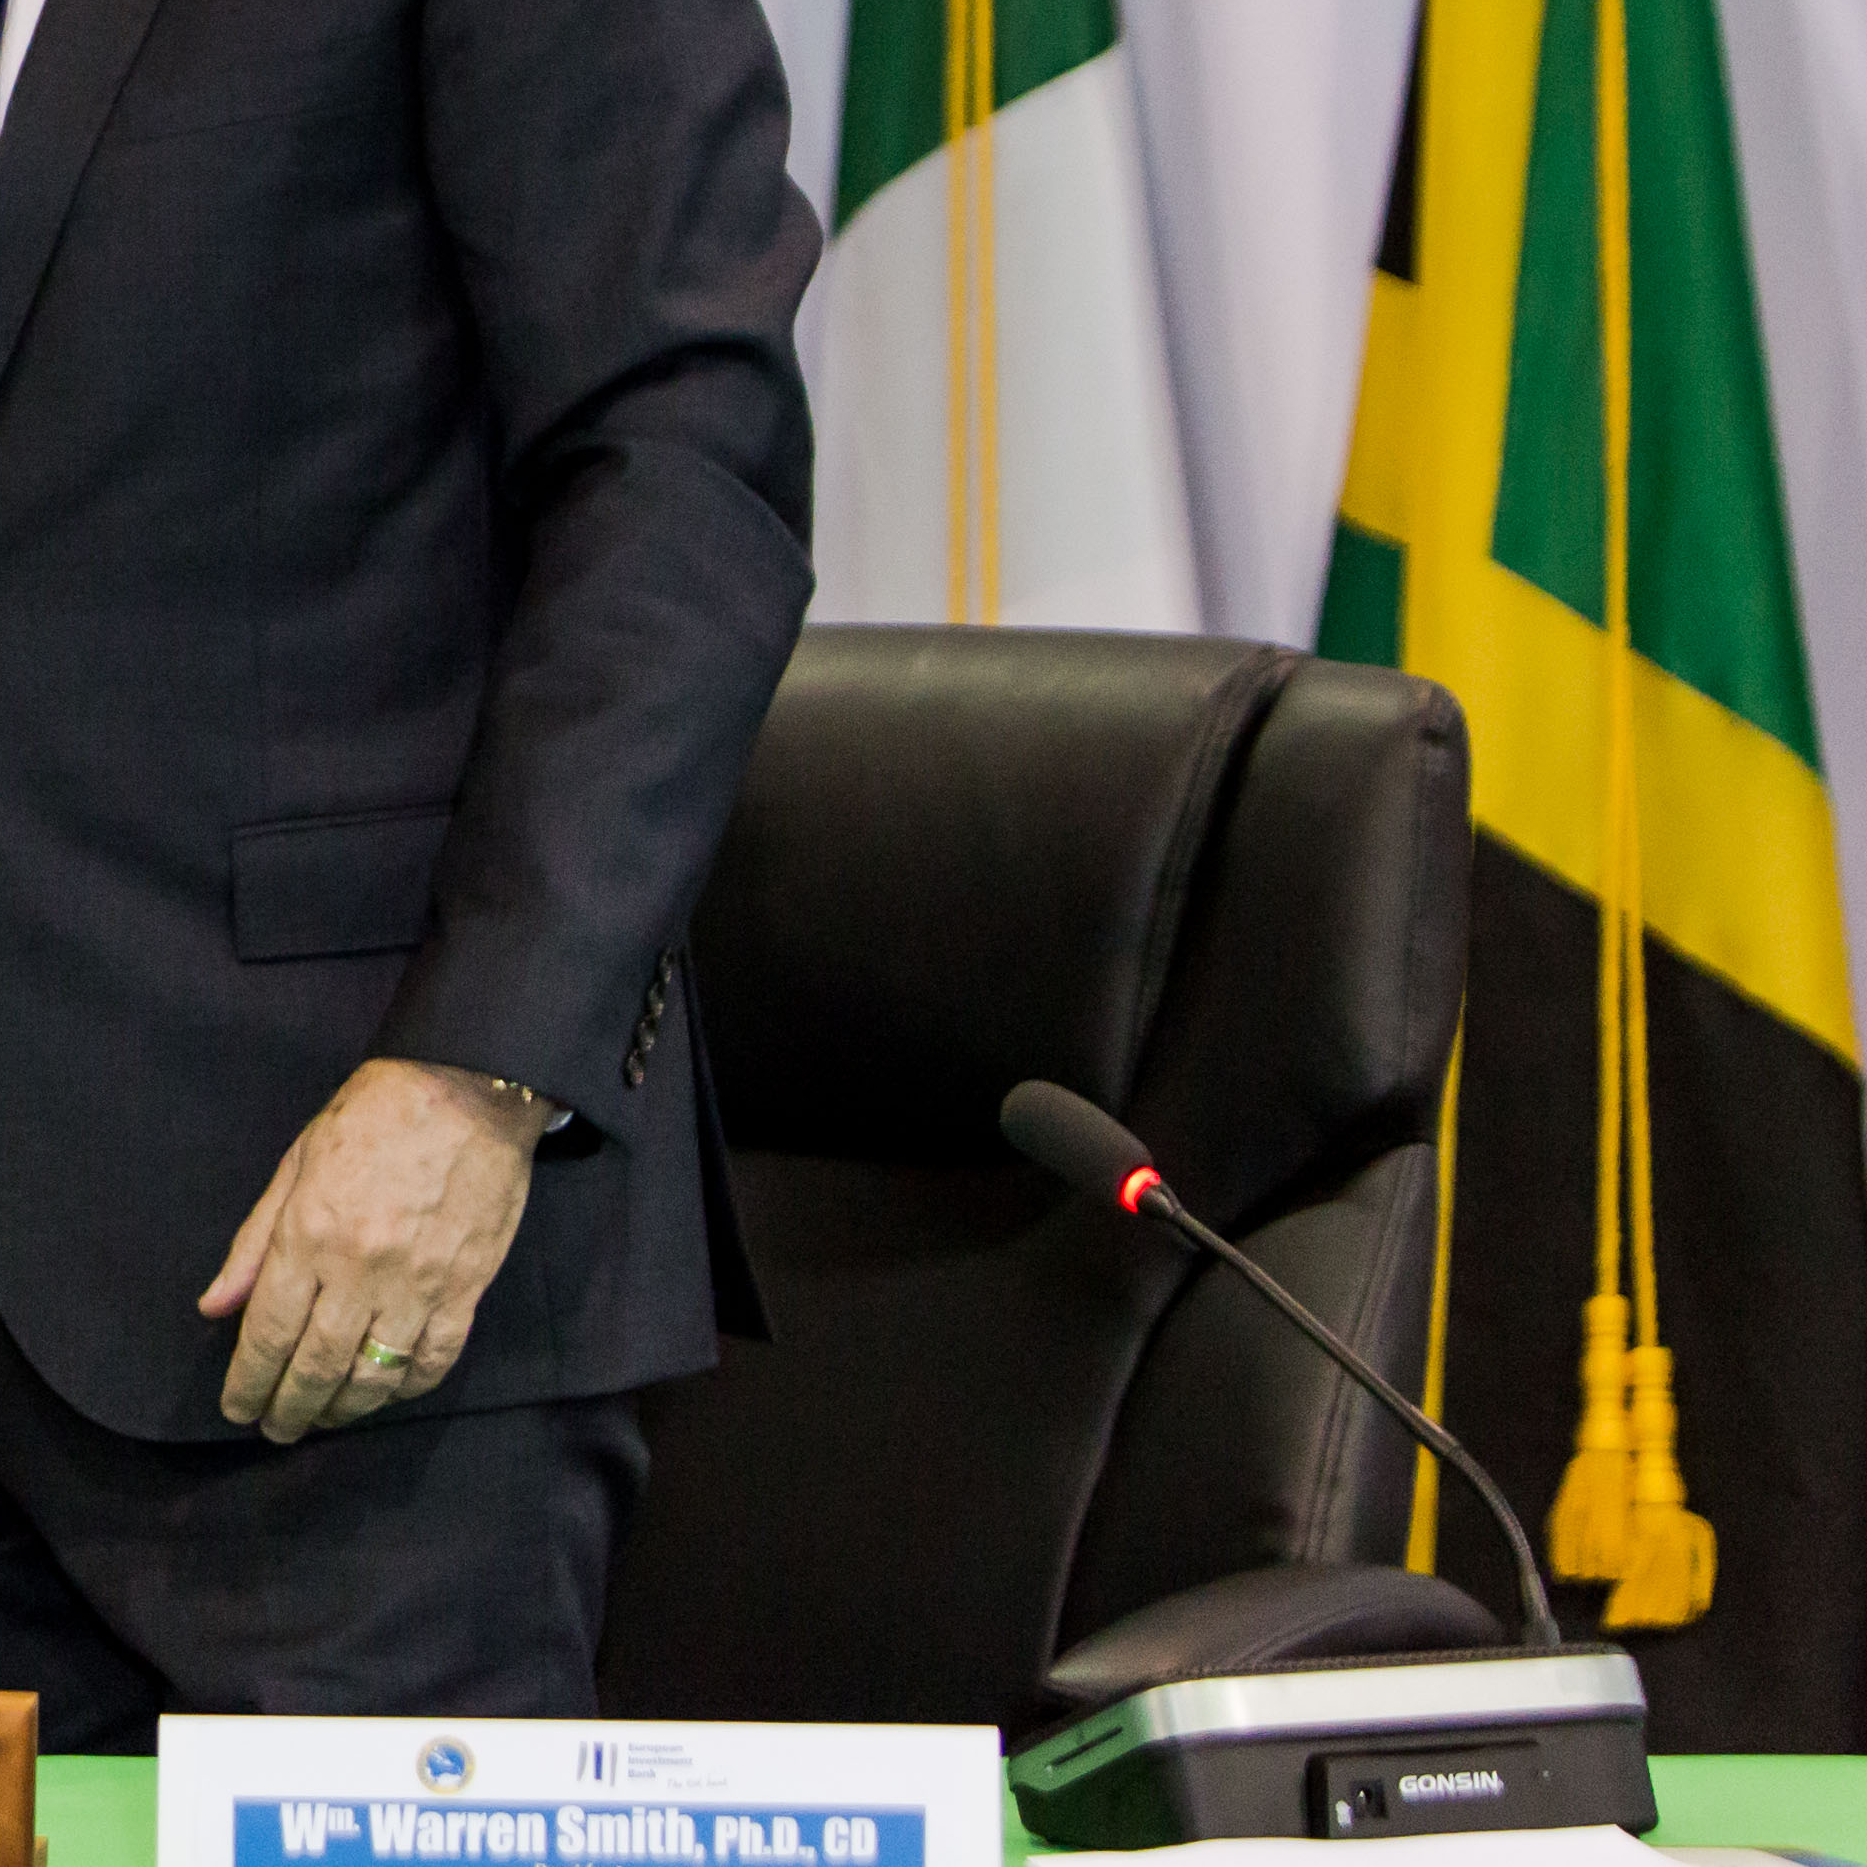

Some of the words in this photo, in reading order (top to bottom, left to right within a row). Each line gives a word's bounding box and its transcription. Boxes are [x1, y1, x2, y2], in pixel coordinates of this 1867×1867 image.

[1399, 1771, 1503, 1798] GONSIN
[279, 1801, 359, 1853] Wm.
[369, 1803, 546, 1855] Warren
[556, 1805, 705, 1859] Smith,
[715, 1815, 816, 1858] Ph.D.,
[823, 1816, 877, 1857] CD
